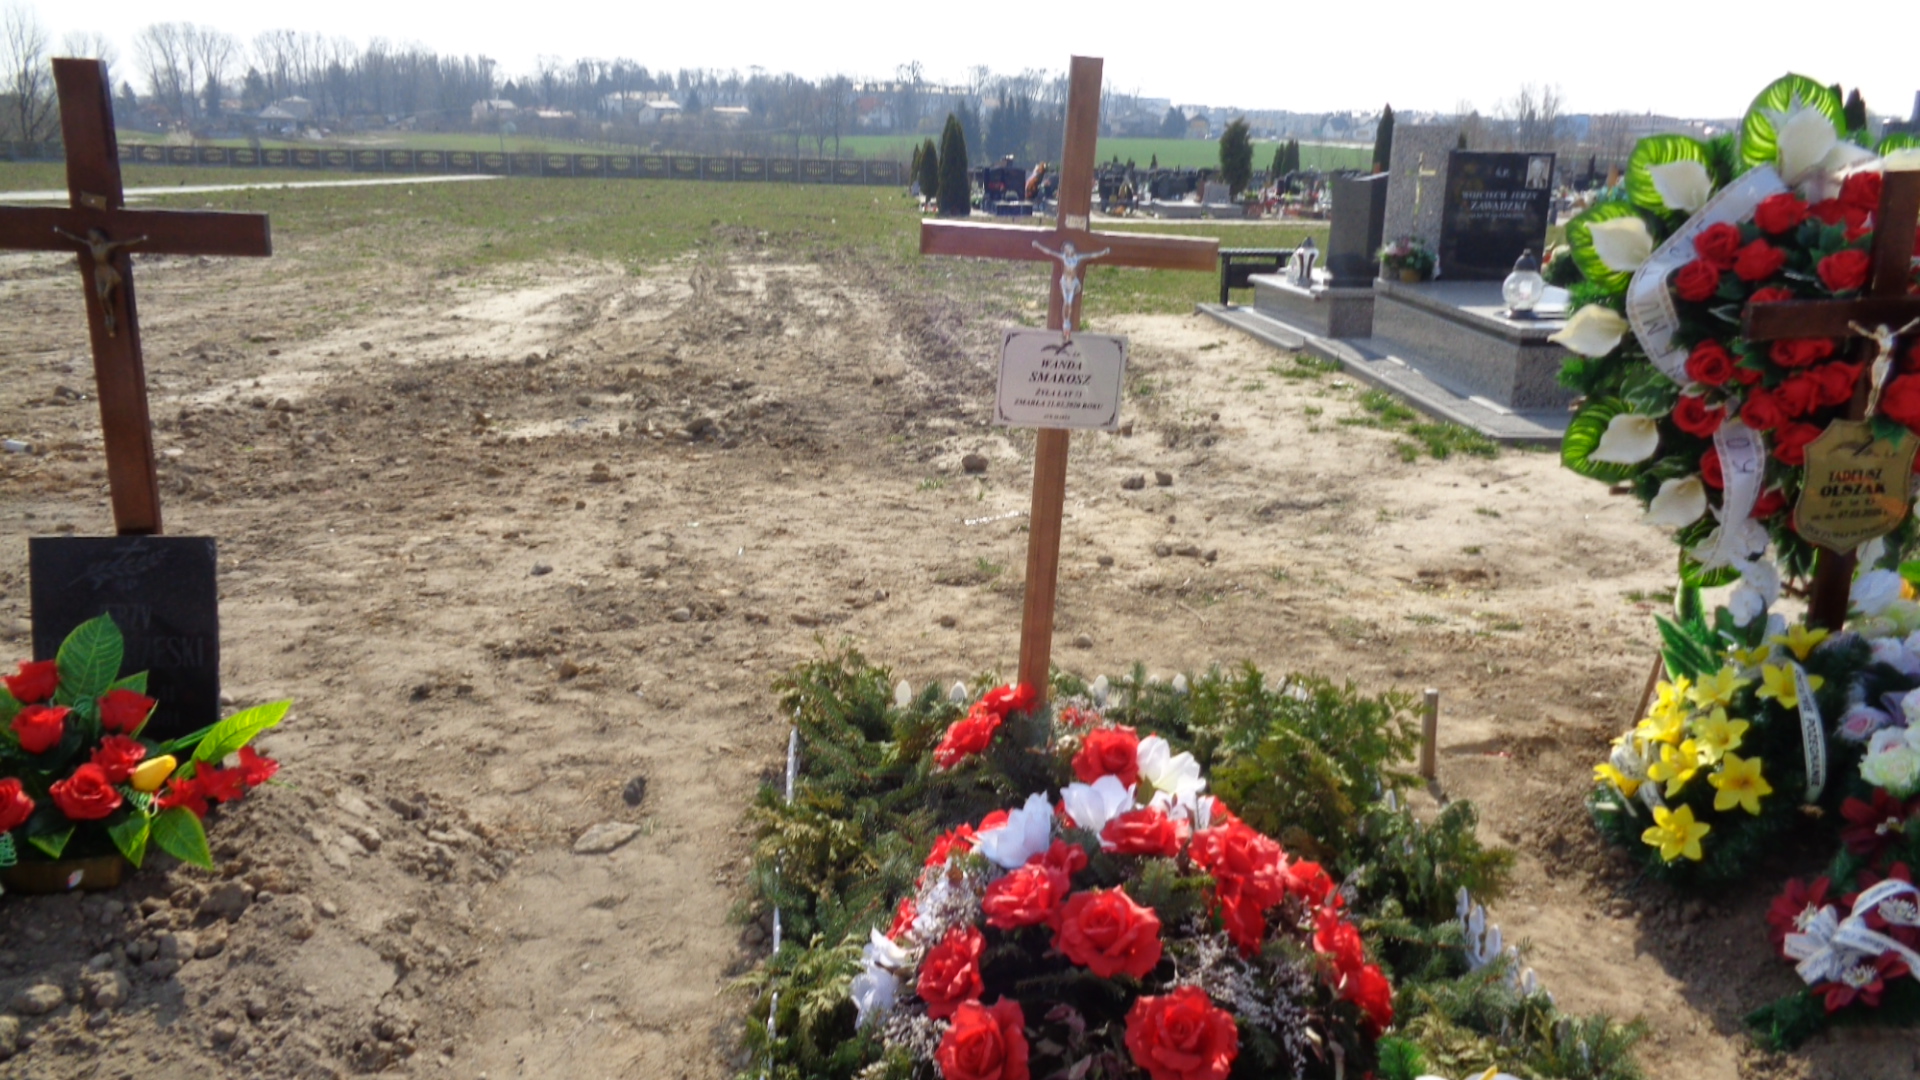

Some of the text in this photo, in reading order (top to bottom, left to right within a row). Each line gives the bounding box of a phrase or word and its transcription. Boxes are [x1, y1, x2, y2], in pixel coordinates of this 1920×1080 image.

[1510, 190, 1539, 200] JERZY
[1469, 201, 1528, 211] ZAWADZKI
[1040, 358, 1082, 371] WANDA
[1028, 370, 1092, 386] SMAKOSZ
[1828, 468, 1884, 482] TADEUSZ
[1819, 482, 1887, 498] OLSZAK
